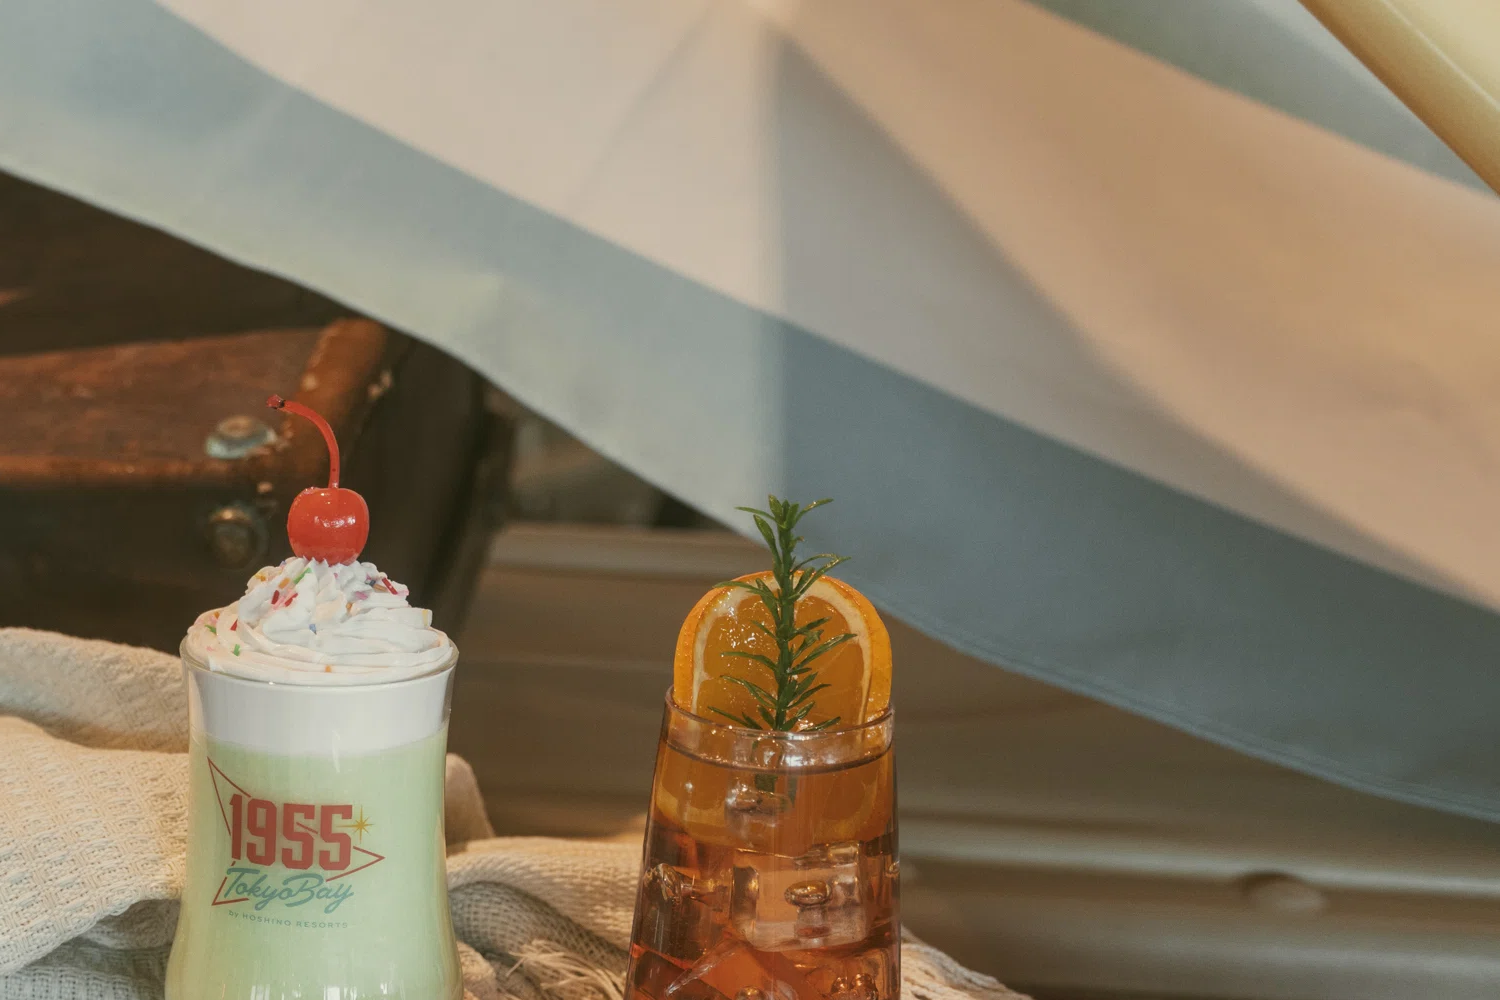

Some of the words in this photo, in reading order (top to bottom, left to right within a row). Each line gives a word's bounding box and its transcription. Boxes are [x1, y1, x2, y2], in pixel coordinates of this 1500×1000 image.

[229, 793, 353, 871] 1955
[228, 910, 240, 919] by
[242, 913, 292, 928] HOSHINO
[296, 920, 349, 930] RESORTS
